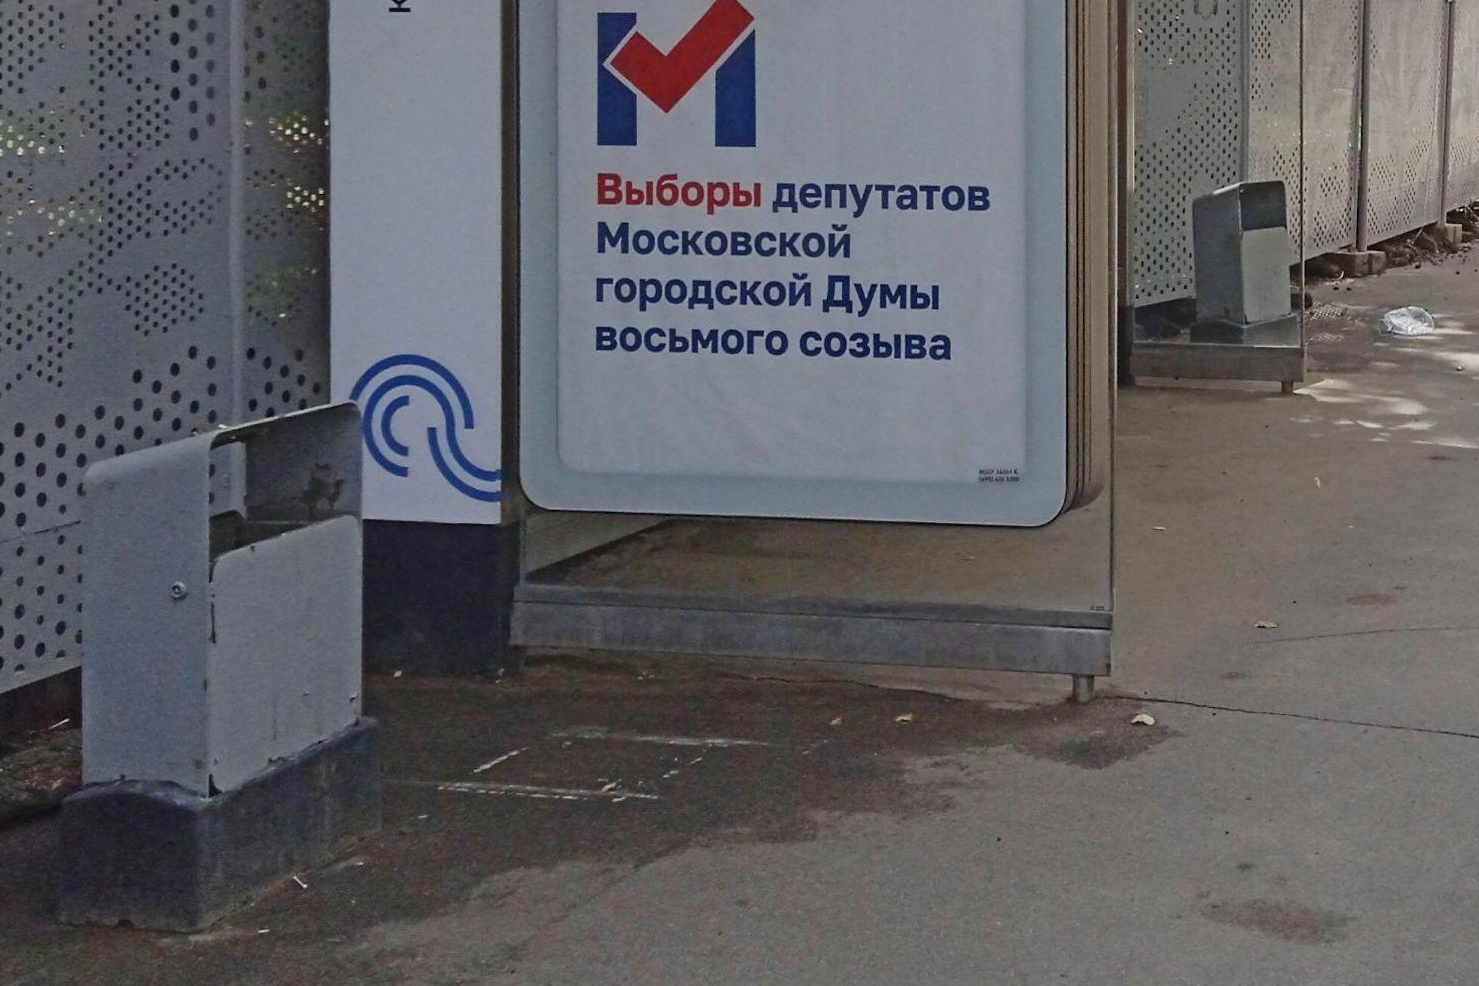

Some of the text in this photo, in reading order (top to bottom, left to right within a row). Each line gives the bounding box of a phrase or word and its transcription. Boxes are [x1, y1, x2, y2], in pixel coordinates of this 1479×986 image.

[597, 172, 991, 219] Выборы депутатов
[597, 222, 852, 259] Московской
[596, 273, 940, 318] городской Думы
[596, 326, 952, 361] восьмого созыва
